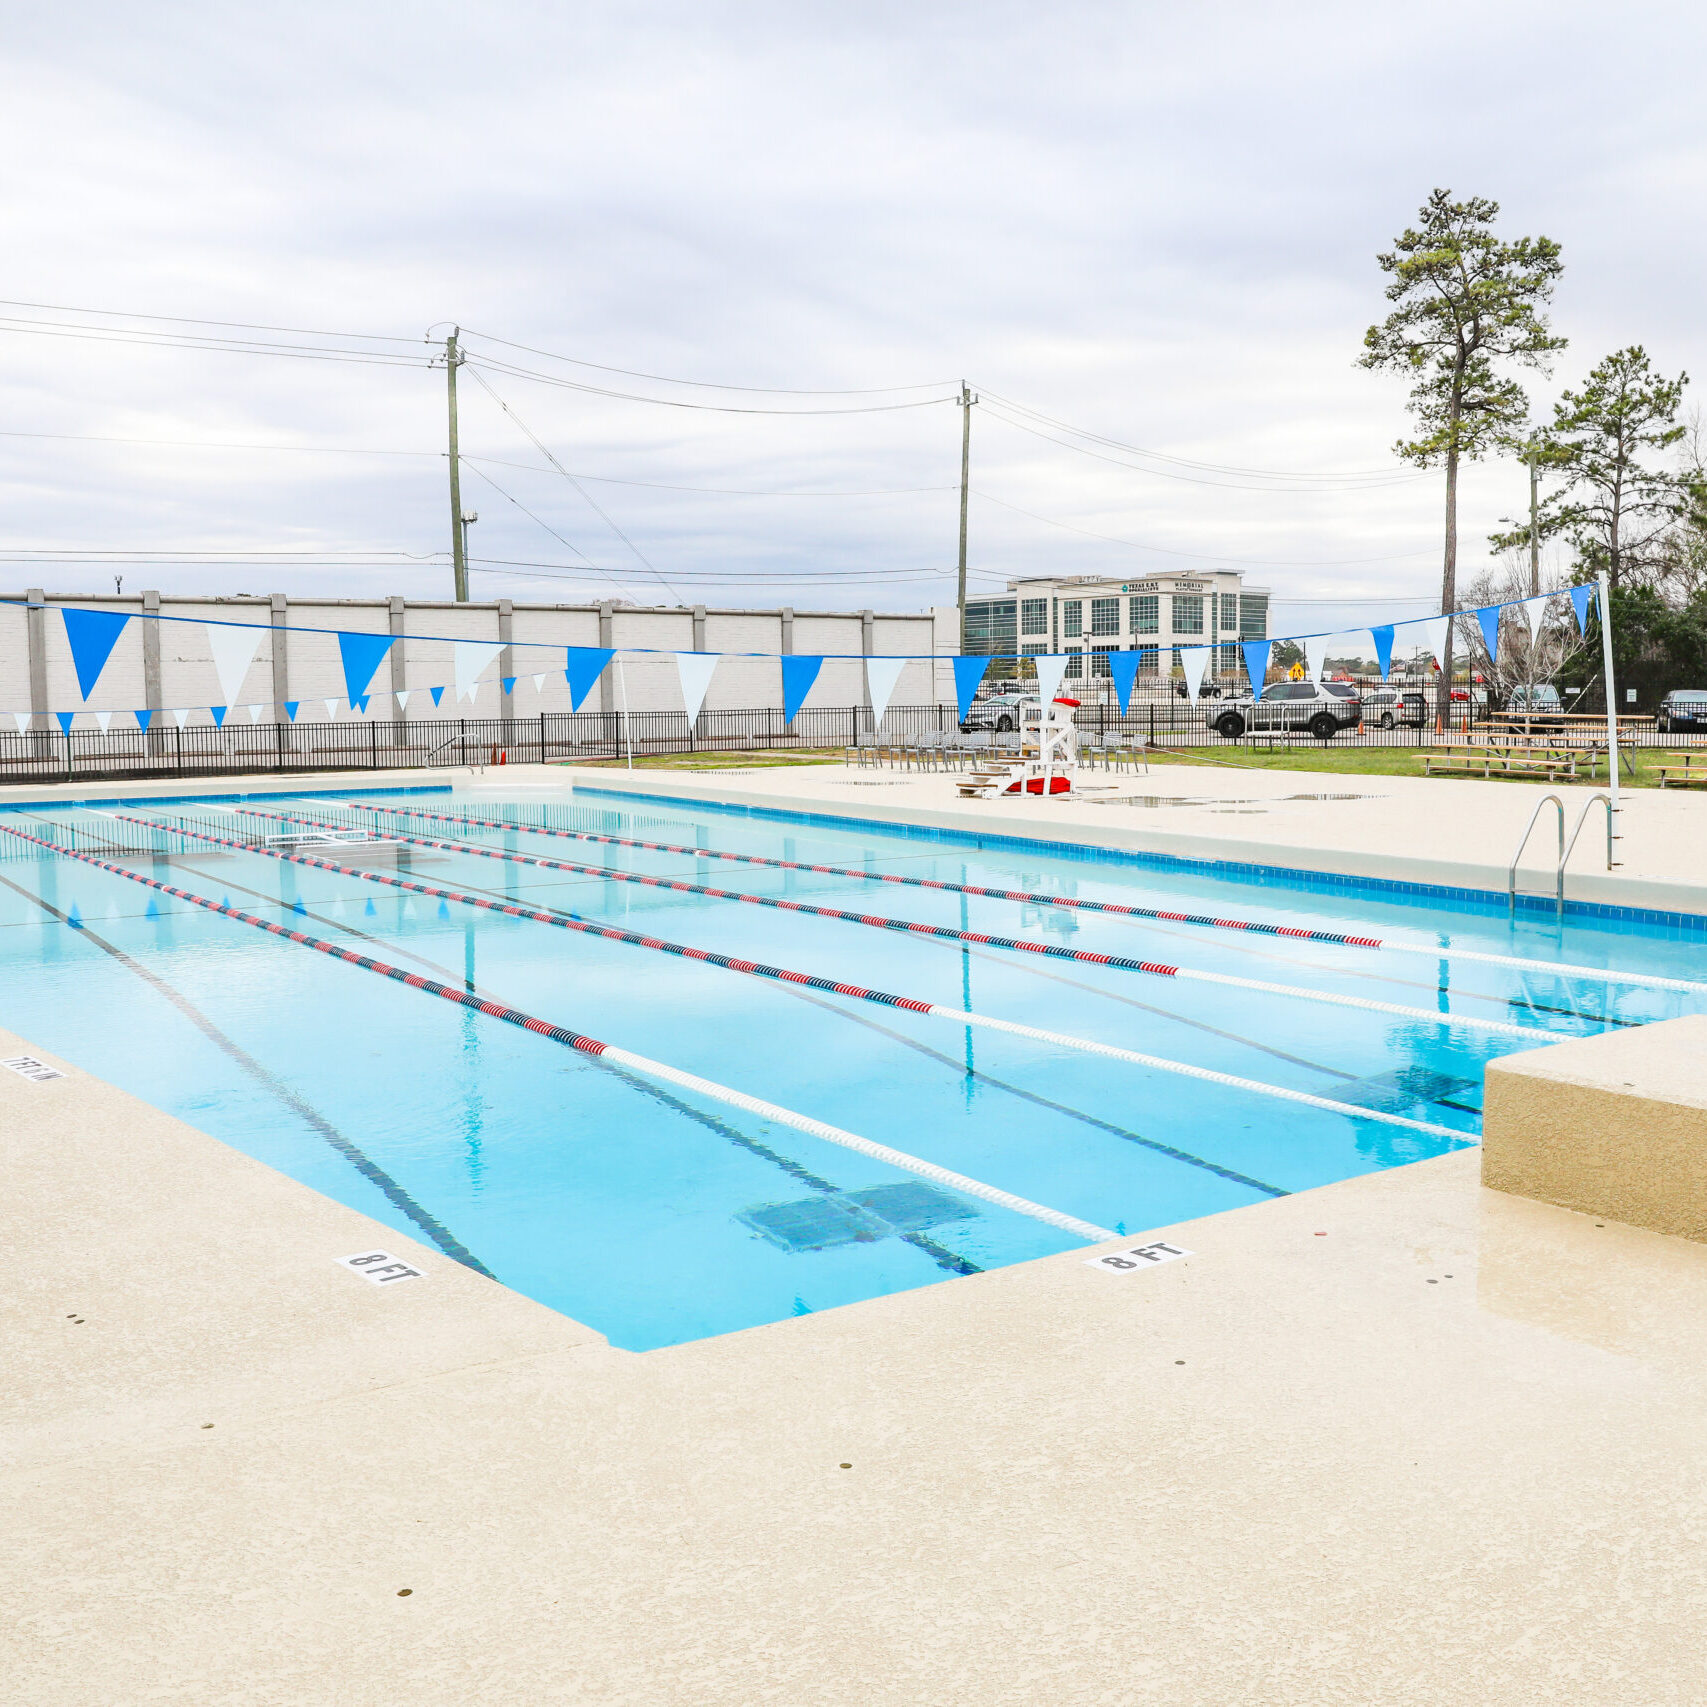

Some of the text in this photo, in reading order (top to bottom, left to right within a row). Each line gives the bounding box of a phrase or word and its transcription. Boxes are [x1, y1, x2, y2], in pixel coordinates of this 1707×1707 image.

[348, 1254, 421, 1282] 8 FT
[1101, 1242, 1183, 1269] 8 FT
